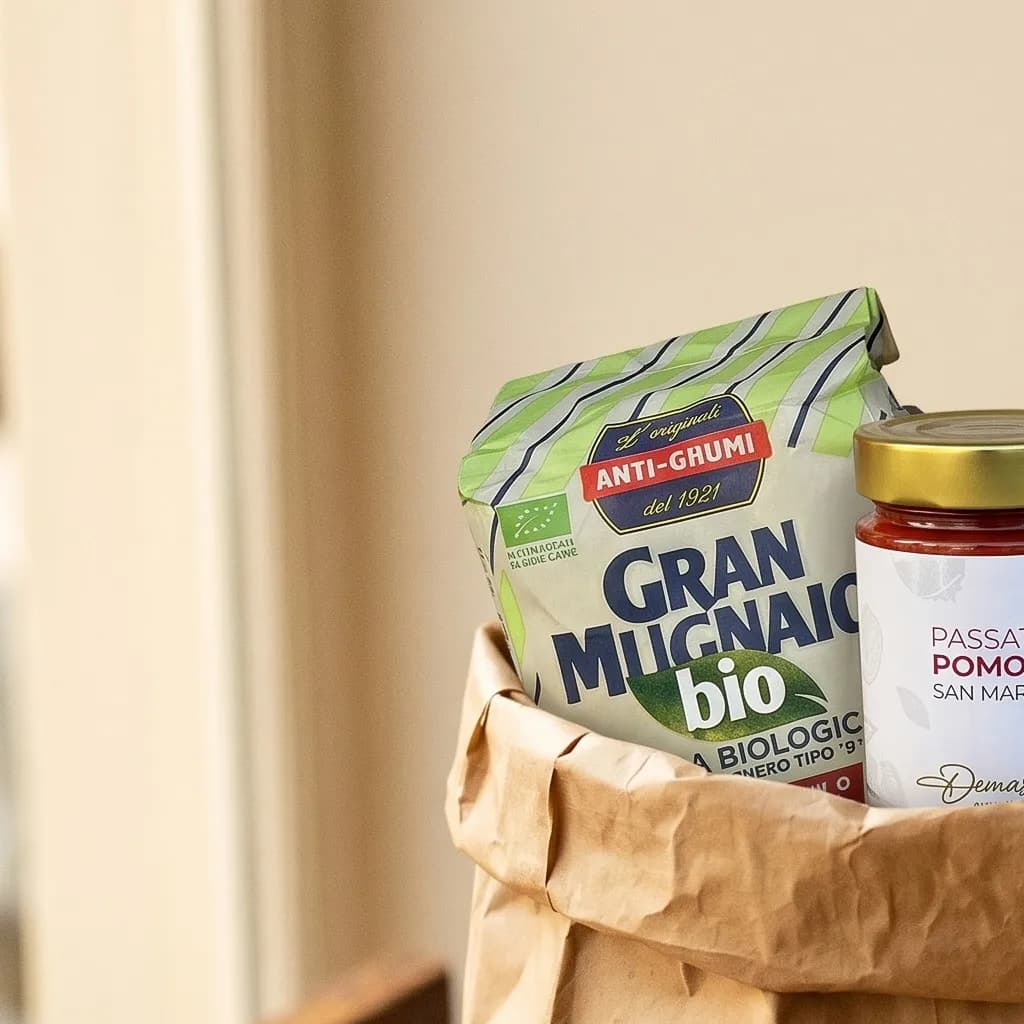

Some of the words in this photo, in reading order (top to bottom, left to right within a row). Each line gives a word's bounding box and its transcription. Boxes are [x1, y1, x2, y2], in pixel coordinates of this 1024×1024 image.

[643, 497, 670, 516] del
[678, 482, 721, 509] 1921
[602, 519, 805, 624] GRAN
[675, 656, 787, 734] bio
[932, 683, 974, 701] SAN
[717, 711, 863, 769] BIOLOGIC
[794, 746, 834, 768] TIPO
